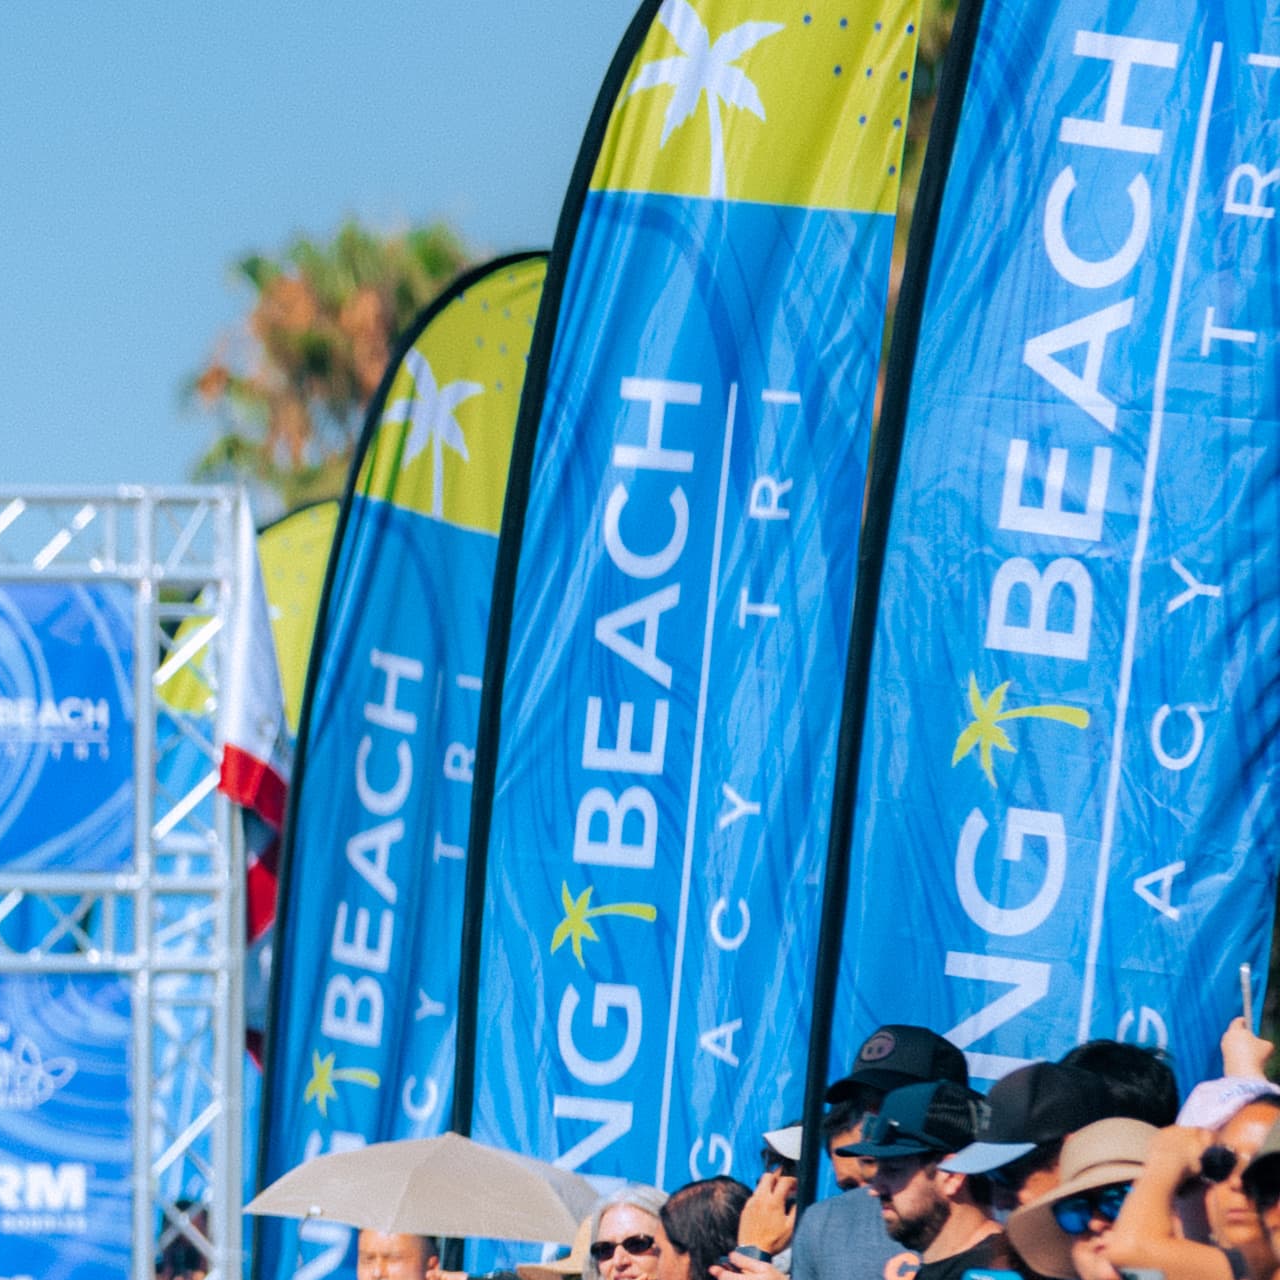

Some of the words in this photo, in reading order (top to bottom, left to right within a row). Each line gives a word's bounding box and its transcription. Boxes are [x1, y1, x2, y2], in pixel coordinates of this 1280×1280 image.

[984, 30, 1180, 661] BEACH
[572, 376, 703, 869] BEACH
[738, 388, 802, 629] TRI
[321, 647, 425, 1048] BEACH
[433, 673, 484, 866] TRI
[944, 806, 1067, 1082] NG
[552, 982, 642, 1195] NG
